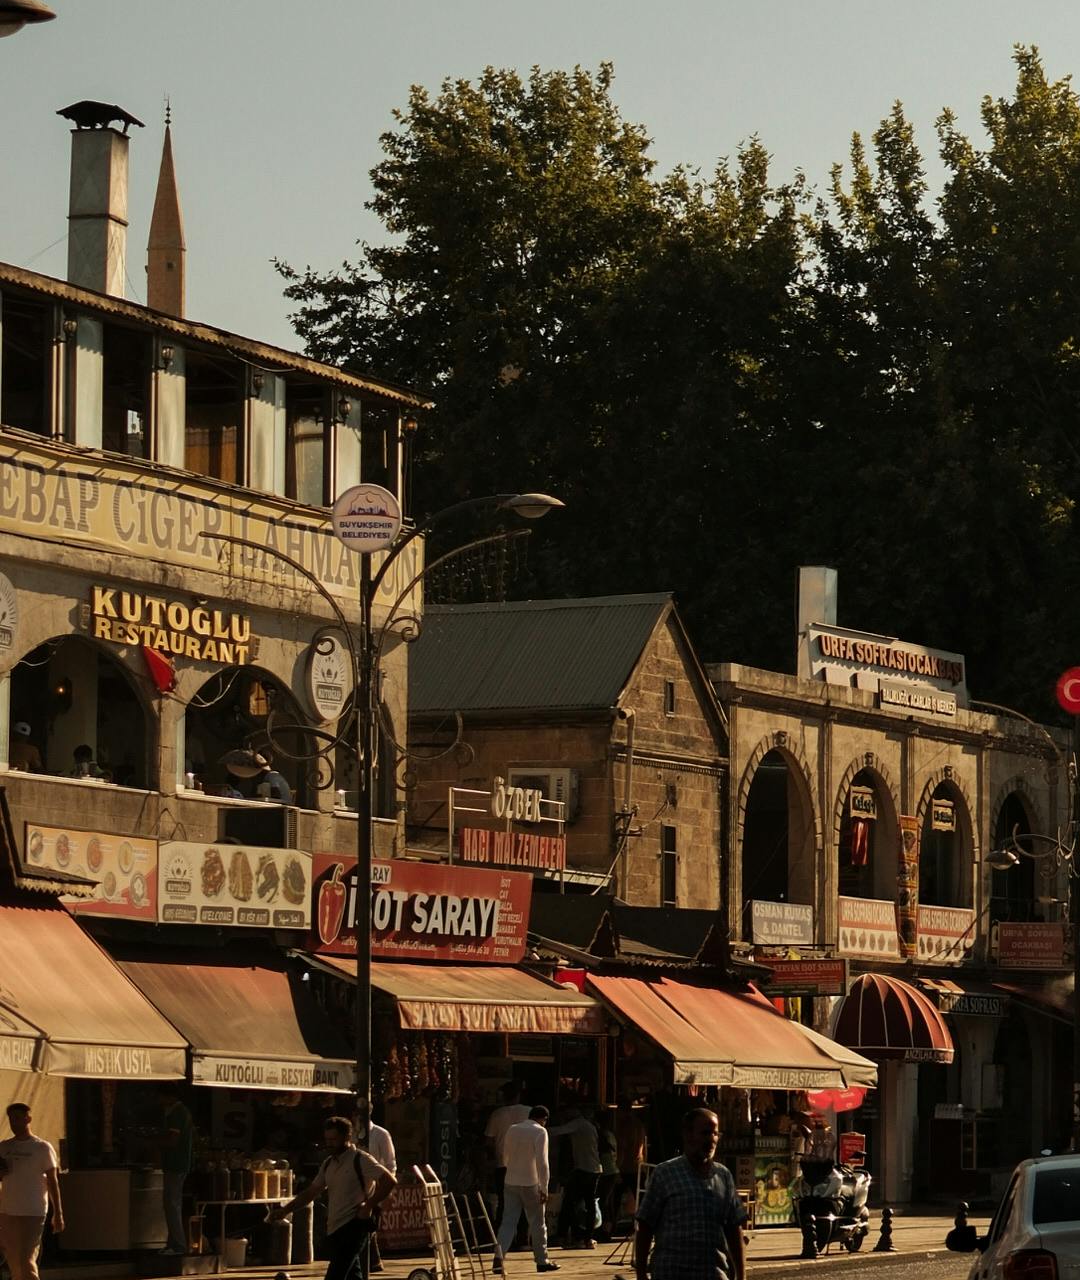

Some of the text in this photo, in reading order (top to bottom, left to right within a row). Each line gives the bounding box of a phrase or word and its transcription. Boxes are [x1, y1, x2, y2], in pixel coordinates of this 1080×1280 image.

[239, 510, 417, 609] LAHMAUN
[93, 586, 250, 642] KUTOĞLU
[95, 616, 249, 665] RESTAURANT
[821, 634, 855, 661] URFA
[855, 643, 908, 671] SOFRASI
[493, 776, 542, 822] ÖZBEK
[464, 828, 489, 863] HACI
[202, 910, 232, 921] WELCOME
[347, 876, 499, 937] İOT SARAYI
[754, 904, 783, 919] OSMAN
[763, 922, 804, 937] & DANTEL
[124, 1050, 152, 1074] USTA
[215, 1062, 340, 1088] KUTOĞLU RESTAURANT
[392, 1188, 422, 1208] SARAY
[402, 1209, 426, 1228] SARA
